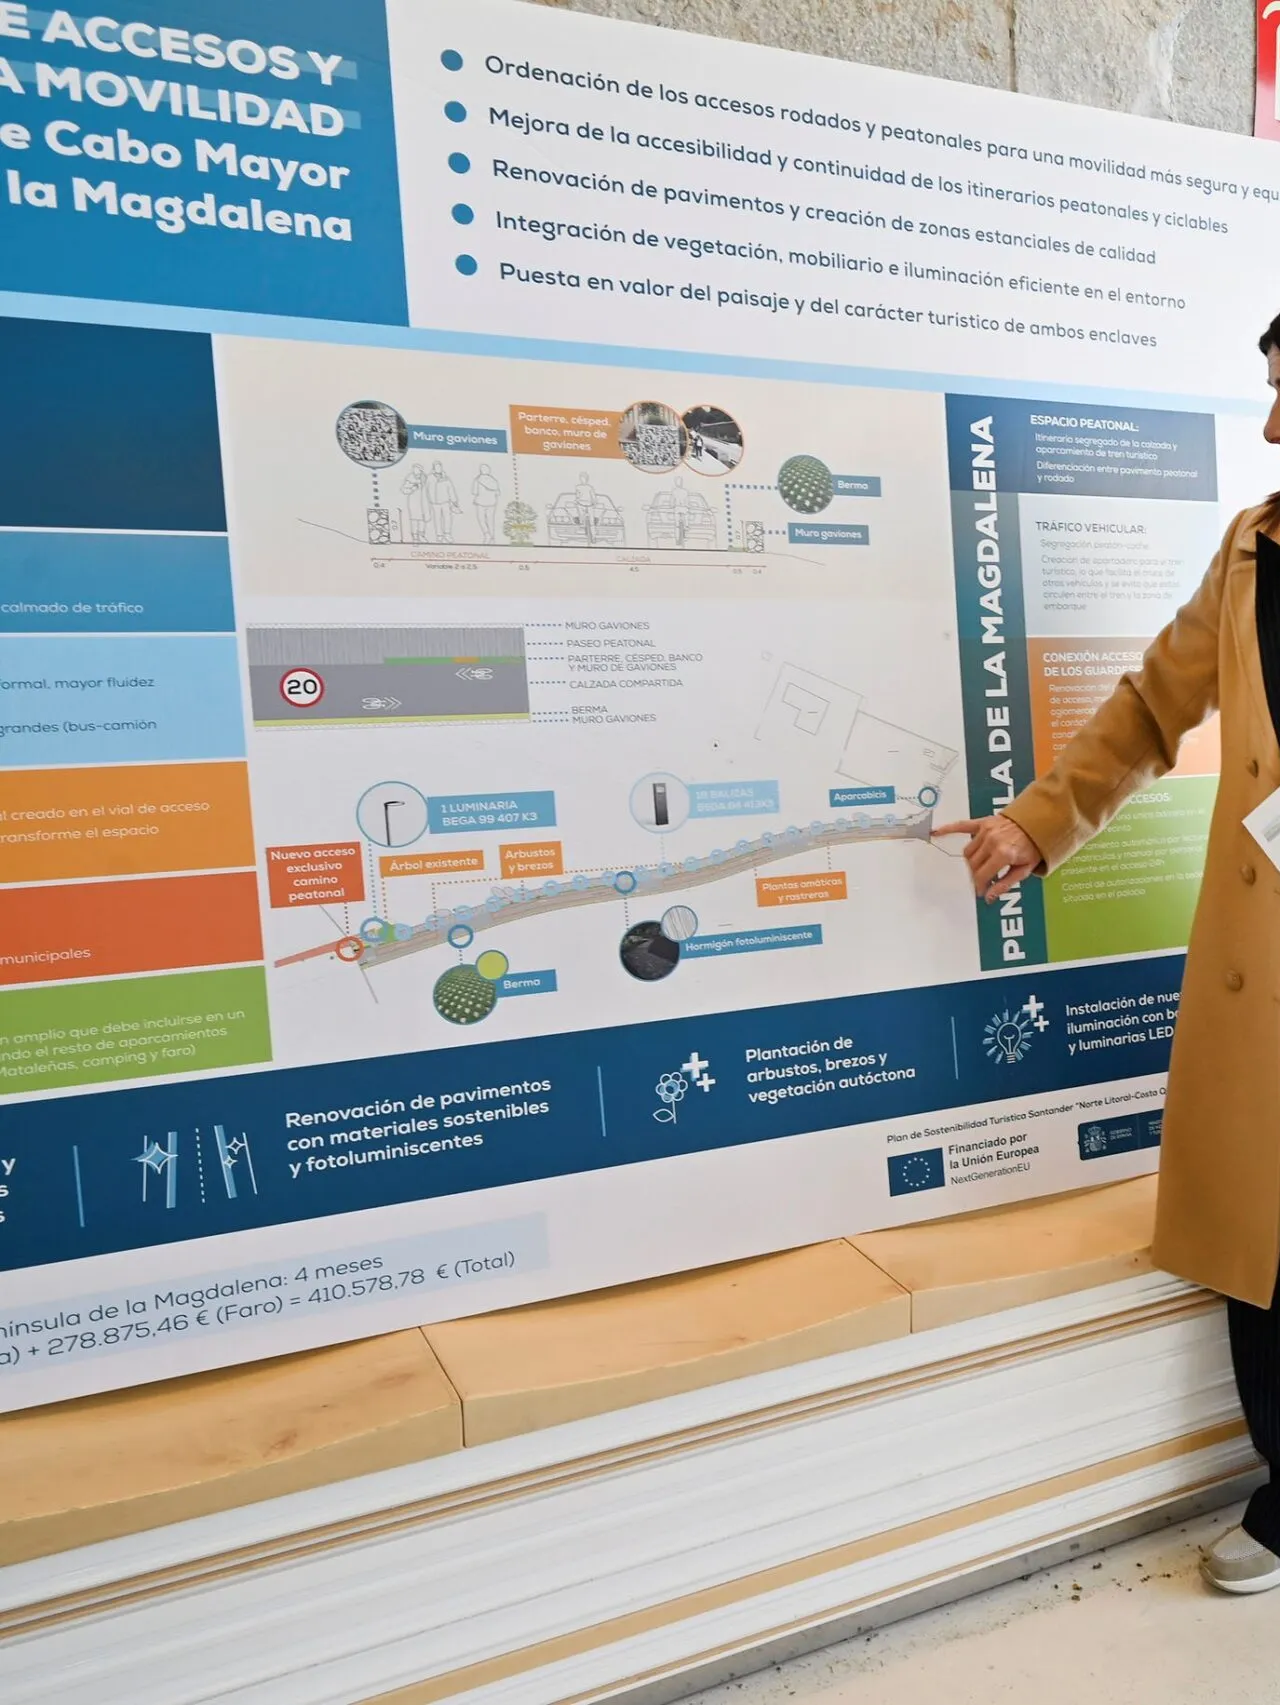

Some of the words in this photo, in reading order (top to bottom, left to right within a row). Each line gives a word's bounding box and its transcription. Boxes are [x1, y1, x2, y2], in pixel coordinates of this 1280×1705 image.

[42, 10, 299, 79] ACCESOS
[308, 51, 342, 85] Y
[36, 63, 344, 136] MOVILIDAD
[486, 56, 619, 93] Ordenación
[627, 80, 653, 98] de
[660, 84, 688, 104] los
[695, 95, 775, 118] accesos
[781, 109, 861, 132] rodados
[866, 123, 876, 139] y
[882, 126, 982, 152] peatonales
[988, 144, 1028, 160] para
[1033, 151, 1064, 166] una
[1070, 157, 1146, 179] movilidad
[1151, 170, 1182, 185] más
[1186, 176, 1237, 195] segura
[1241, 186, 1249, 200] y
[45, 120, 182, 168] Cabo
[195, 139, 349, 189] Mayor
[490, 108, 569, 136] Mejora
[577, 122, 604, 141] de
[611, 126, 629, 144] la
[637, 135, 772, 165] accesibilidad
[778, 156, 788, 172] y
[794, 158, 905, 185] continuidad
[912, 173, 933, 189] de
[939, 176, 963, 194] los
[968, 180, 1055, 208] itinerarios
[1060, 199, 1149, 222] peatonales
[1152, 213, 1161, 227] y
[1165, 212, 1228, 234] ciclables
[7, 170, 57, 208] la
[72, 178, 352, 241] Magdalena
[494, 160, 624, 193] Renovación
[632, 180, 657, 198] de
[664, 188, 784, 215] pavimentos
[790, 205, 800, 221] y
[806, 208, 886, 228] creación
[892, 216, 914, 232] de
[920, 223, 970, 240] zonas
[976, 230, 1070, 253] estanciales
[1075, 241, 1094, 256] de
[1100, 246, 1156, 264] calidad
[500, 263, 580, 287] Puesta
[588, 277, 613, 291] en
[620, 279, 674, 297] valor
[680, 284, 711, 301] del
[718, 290, 789, 313] paisaje
[795, 299, 805, 315] y
[811, 298, 838, 314] del
[845, 304, 924, 322] carácter
[1005, 318, 1025, 333] de
[1030, 323, 1085, 340] ambos
[1090, 330, 1157, 347] enclaves
[1031, 415, 1078, 427] ESPACIO
[414, 432, 444, 442] Muro
[447, 435, 498, 445] gaviones
[838, 480, 868, 490] Berma
[970, 416, 1005, 644] MAGDALENA
[1036, 520, 1083, 532] TRÁFICO
[1, 602, 68, 613] calmado
[72, 602, 92, 613] de
[96, 602, 144, 613] tráfico
[566, 622, 597, 630] MURO
[599, 622, 650, 630] GAVIONES
[567, 640, 601, 648] PASEO
[604, 640, 656, 648] PEATONAL
[55, 680, 103, 691] mayor
[107, 677, 155, 687] fluidez
[984, 651, 1008, 697] LA
[287, 679, 317, 695] 20
[986, 706, 1013, 753] DE
[450, 801, 518, 813] LUMINARIA
[834, 791, 887, 802] Aparcabicis
[11, 808, 65, 820] creado
[69, 809, 89, 817] en
[92, 806, 105, 816] el
[109, 804, 134, 815] vial
[138, 804, 157, 814] de
[160, 802, 210, 813] acceso
[271, 852, 311, 860] Nuevo
[314, 848, 355, 858] acceso
[425, 858, 478, 868] existente
[287, 862, 343, 873] exclusivo
[294, 876, 338, 886] camino
[289, 888, 345, 903] peatonal
[685, 939, 735, 951] Hormigón
[736, 932, 813, 946] fotoluminiscente
[0, 949, 91, 965] municipales
[1066, 997, 1136, 1016] Instalación
[1139, 994, 1155, 1006] de
[1067, 1014, 1139, 1034] iluminación
[1142, 1012, 1164, 1023] con
[746, 1040, 830, 1062] Plantación
[834, 1037, 853, 1050] de
[1068, 1044, 1076, 1056] y
[1079, 1032, 1146, 1051] luminarias
[1149, 1026, 1174, 1040] LED
[747, 1064, 822, 1083] arbustos,
[826, 1055, 876, 1073] brezos
[879, 1053, 887, 1066] y
[749, 1080, 835, 1104] vegetación
[839, 1068, 915, 1088] autóctona
[286, 1100, 405, 1128] Renovación
[410, 1095, 435, 1110] de
[440, 1080, 551, 1110] pavimentos
[288, 1136, 324, 1151] con
[330, 1118, 438, 1145] materiales
[444, 1102, 549, 1127] sostenibles
[948, 1137, 1007, 1155] Financiado
[1010, 1134, 1027, 1146] por
[289, 1163, 301, 1178] y
[306, 1135, 483, 1172] fotoluminiscentes
[950, 1160, 959, 1169] la
[962, 1154, 993, 1167] Unión
[996, 1146, 1039, 1161] Europea
[951, 1162, 1030, 1185] NextGenerationEU
[89, 1305, 119, 1322] de
[126, 1300, 146, 1315] la
[155, 1276, 288, 1310] Magdalena:
[295, 1267, 308, 1282] 4
[316, 1257, 383, 1280] meses
[48, 1315, 189, 1356] 278.875,46
[196, 1310, 210, 1326] €
[217, 1296, 283, 1324] (Faro)
[437, 1264, 449, 1279] €
[455, 1251, 515, 1278] (Total)
